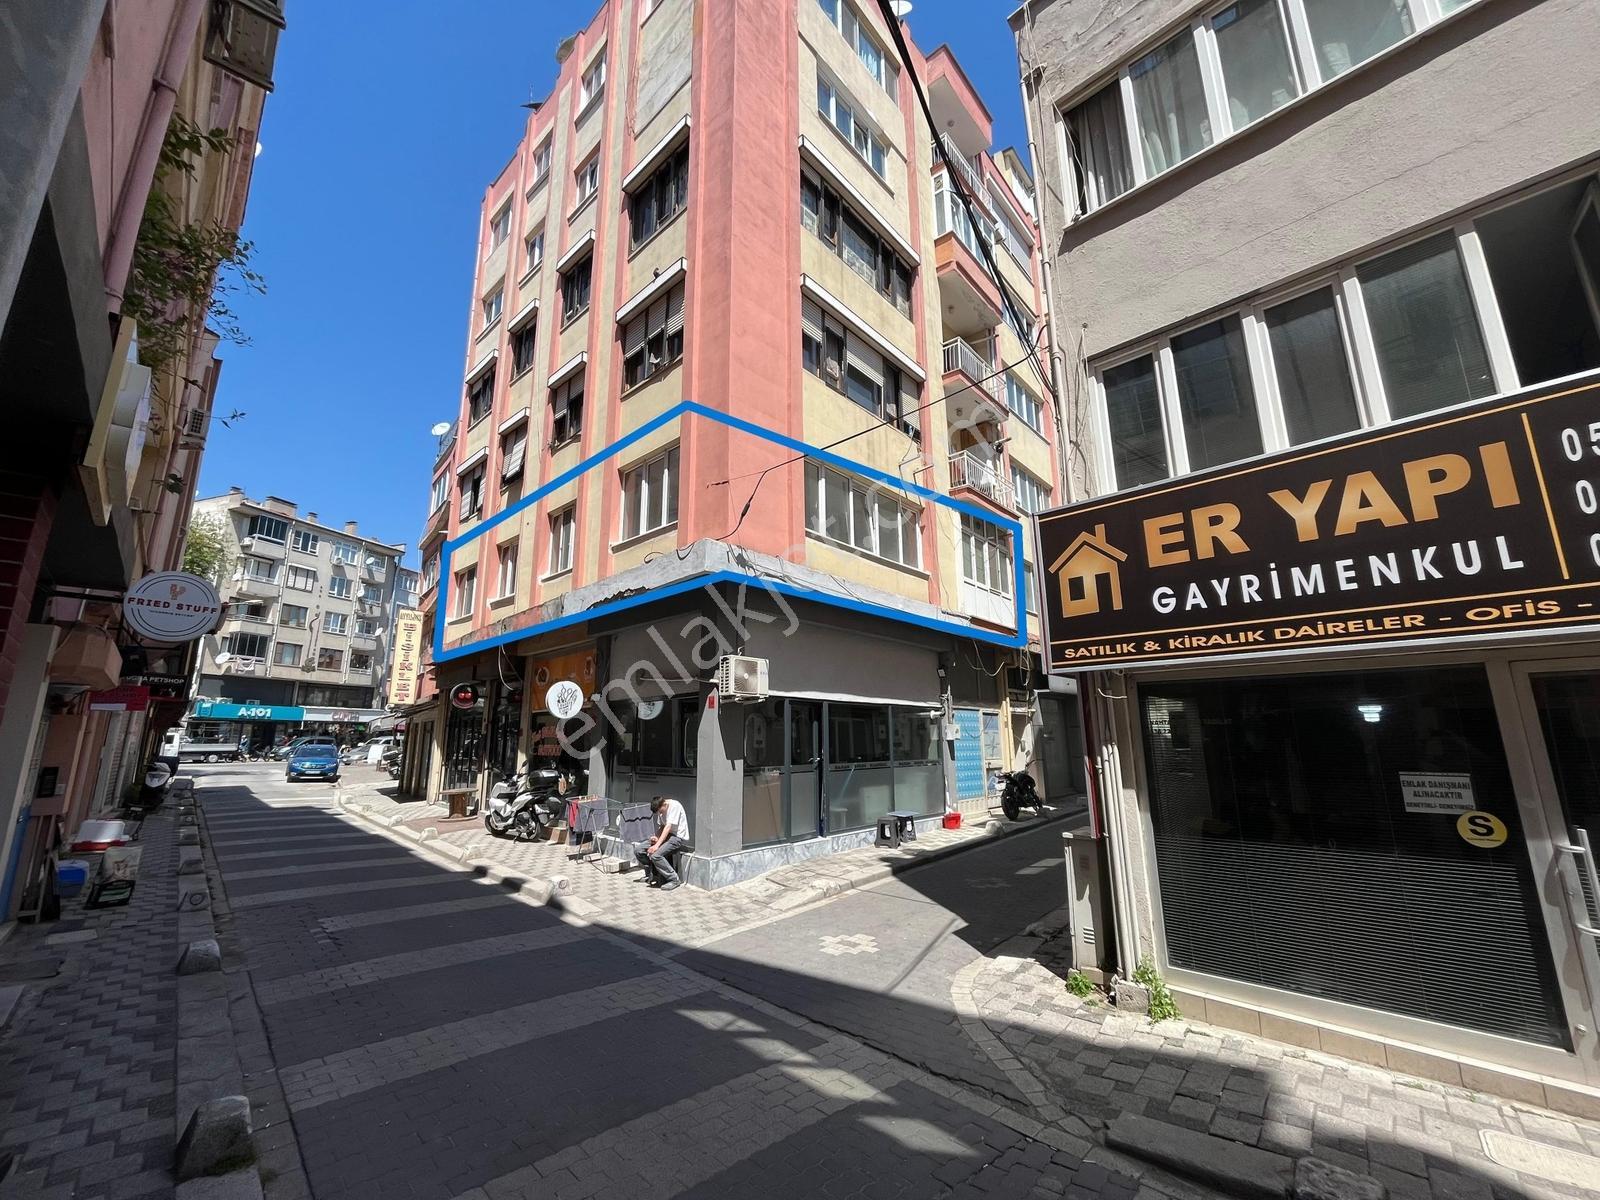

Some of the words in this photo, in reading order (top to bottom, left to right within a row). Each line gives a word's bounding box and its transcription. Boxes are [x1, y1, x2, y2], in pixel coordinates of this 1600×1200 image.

[1143, 502, 1250, 568] ER
[1267, 440, 1521, 542] YAPI
[1151, 535, 1524, 614] GAYRİMENKUL
[127, 596, 170, 609] FRIED
[175, 603, 218, 614] STUFF
[1064, 642, 1137, 659] SATILIK
[1143, 640, 1161, 652] &
[1168, 629, 1265, 649] KİRALIK
[1273, 613, 1426, 640] DAİRELER
[1465, 599, 1561, 622] OFİS
[1402, 780, 1427, 788] EMLAK
[1412, 790, 1463, 800] ALINACAKTIR
[1468, 815, 1494, 837] S
